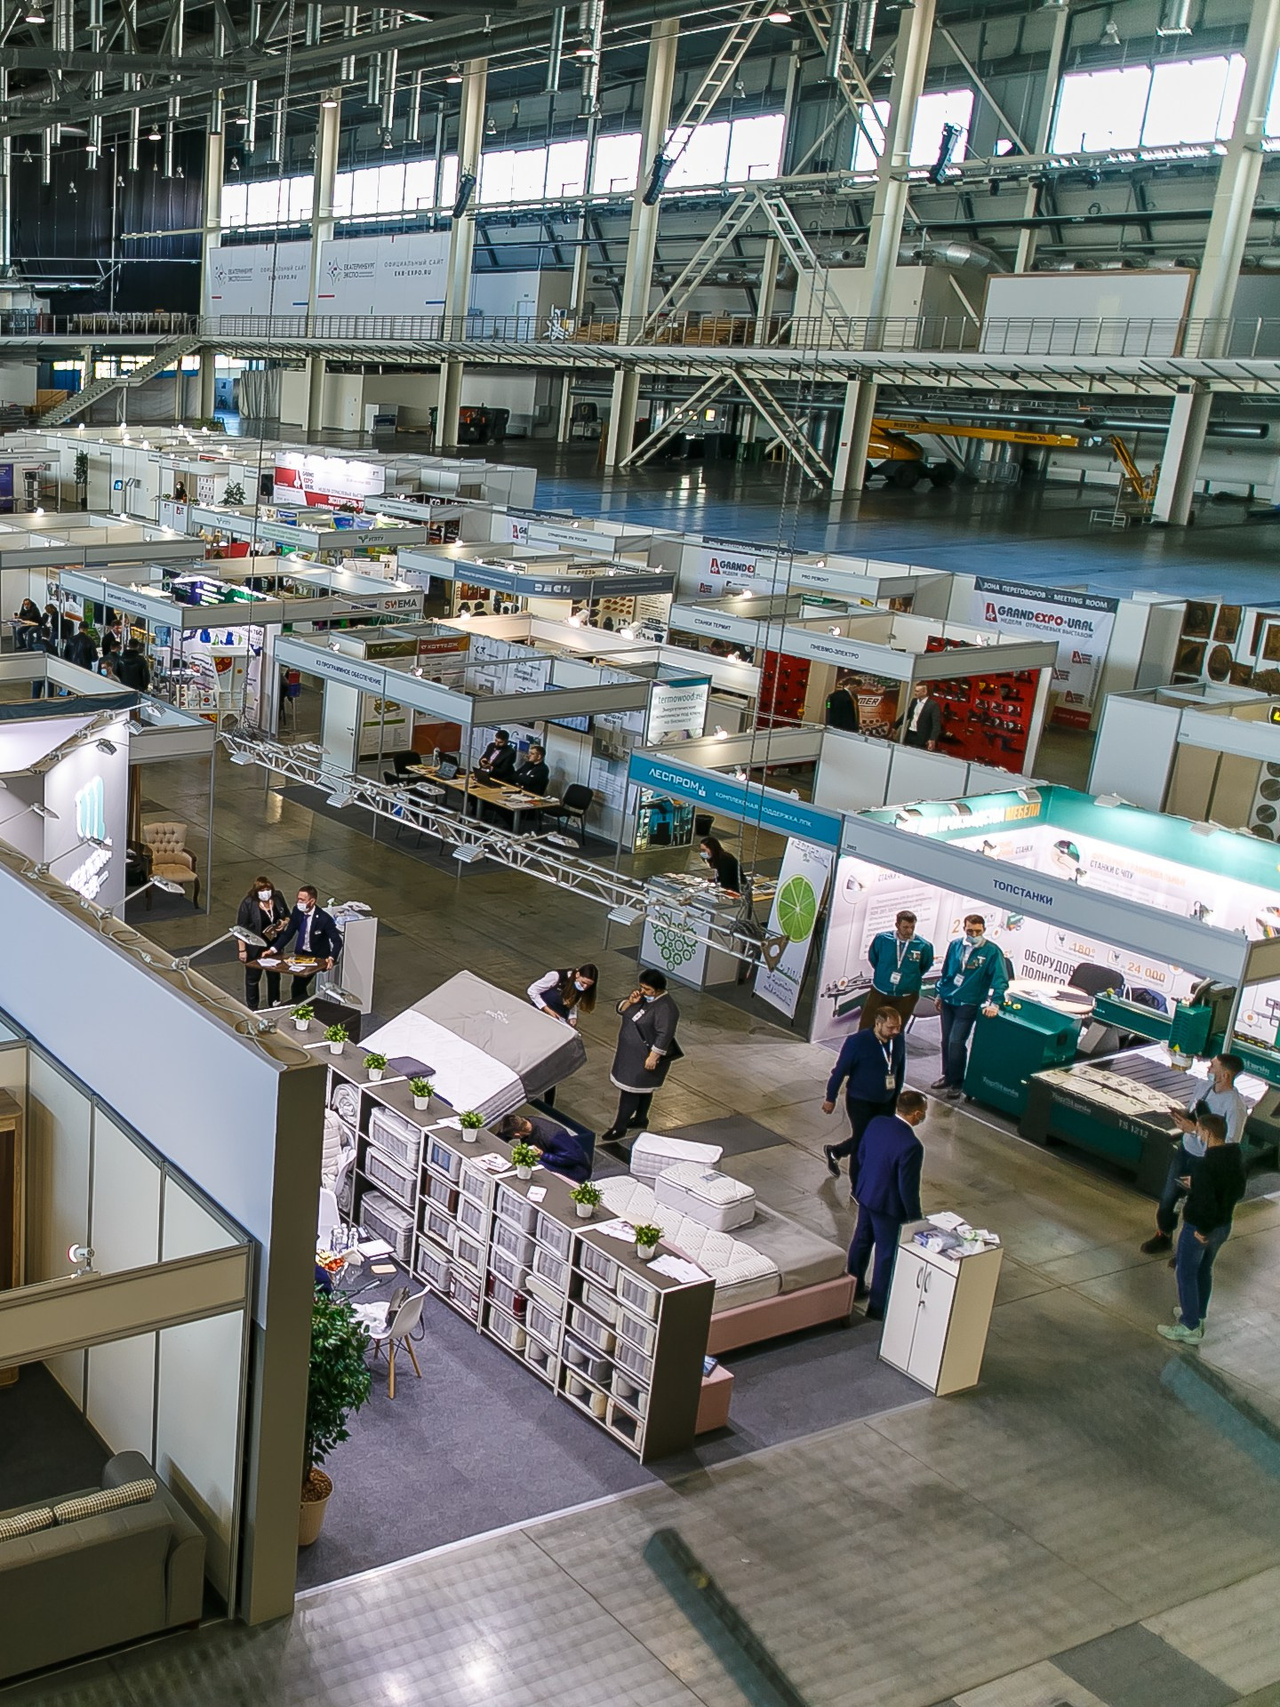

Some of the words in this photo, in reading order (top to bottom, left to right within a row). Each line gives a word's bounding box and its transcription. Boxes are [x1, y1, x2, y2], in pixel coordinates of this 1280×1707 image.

[384, 259, 427, 267] ОФИЦИАЛЬНЫЙ
[983, 582, 1000, 591] ЗОНА
[1002, 585, 1046, 598] ПЕРЕГОВОРОВ
[1054, 594, 1083, 605] MEETING
[1085, 599, 1108, 609] ROOM
[694, 618, 713, 627] СТАНКИ
[713, 622, 732, 631] ТЕРМИТ
[1000, 617, 1022, 626] НЕДЕЛЯ
[1026, 622, 1061, 634] ОТРАСЛЕВЫХ
[1062, 629, 1093, 639] ВЫСТАВОК
[810, 643, 859, 660] ПНЕВМО-ЭЛЕКТРО
[321, 660, 351, 676] ПРОГРАММНОЕ
[351, 669, 382, 686] ОБЕСПЕЧЕНИЕ
[648, 767, 699, 790] ЛЕСПРОМ
[715, 792, 759, 810] КОМПЛЕКСНАЯ
[1005, 803, 1041, 822] МЕБЕЛИ
[1090, 860, 1114, 874] СТАНКИ
[1120, 868, 1133, 880] ЧПУ
[992, 878, 1054, 907] ТОПСТАНКИ
[1024, 949, 1076, 977] ОБОРУДОВ
[1127, 962, 1141, 975] 24
[1145, 967, 1166, 983] 000
